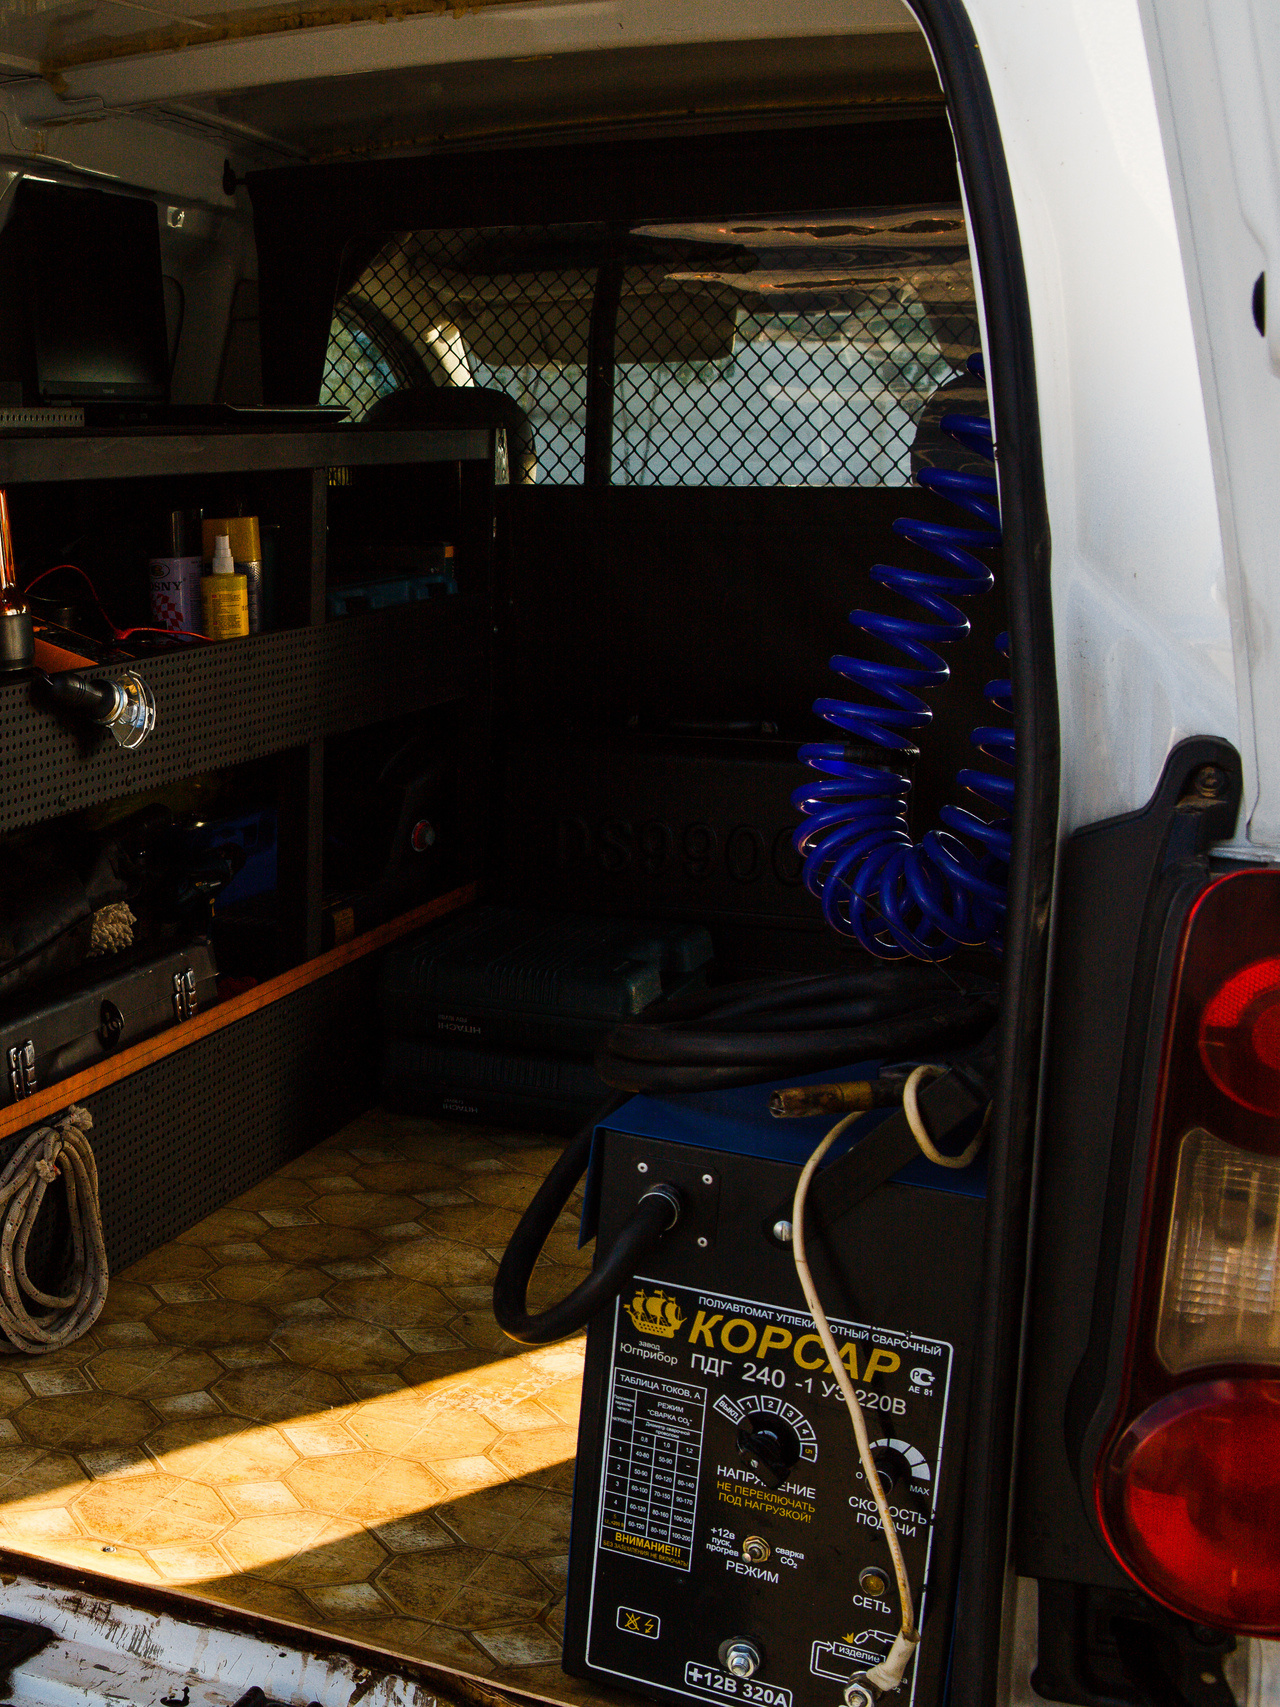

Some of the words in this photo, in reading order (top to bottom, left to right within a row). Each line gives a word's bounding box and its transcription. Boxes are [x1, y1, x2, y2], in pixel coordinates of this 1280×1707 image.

[437, 1021, 482, 1035] HITACHI
[442, 1103, 479, 1114] HITACHI
[698, 1296, 775, 1320] ПОЛУАВТОМАТ
[776, 1312, 870, 1341] УГЛЕКИОТНЫЙ
[871, 1333, 942, 1357] СВАРОЧНЫЙ
[620, 1343, 679, 1366] Югприбор
[638, 1340, 661, 1351] завод
[688, 1310, 901, 1383] КОРСАР
[620, 1374, 660, 1391] ТАБЛИЦА
[661, 1383, 692, 1399] ТОКОВ,
[694, 1392, 701, 1400] А
[690, 1353, 733, 1378] ПДГ
[741, 1362, 786, 1389] 240
[855, 1389, 907, 1415] 220В
[923, 1388, 933, 1397] 81
[657, 1401, 684, 1414] РЕЖИМ
[718, 1400, 739, 1420] ВЫКЛ.
[746, 1401, 753, 1409] 1
[767, 1400, 774, 1409] 2
[786, 1410, 794, 1418] 3
[634, 1468, 649, 1477] 50-90
[655, 1473, 673, 1484] 60-120
[654, 1490, 671, 1500] 70-150
[716, 1480, 732, 1492] НЕ
[734, 1485, 816, 1513] ПЕРЕКЛЮЧАТЬ
[629, 1503, 647, 1513] 60-120
[673, 1514, 693, 1525] 100-200
[718, 1492, 742, 1507] ПОД
[744, 1499, 812, 1524] НАГРУЗКОЙ!
[848, 1496, 927, 1525] СКООСТЬ
[856, 1512, 916, 1538] ПОДЧИ
[615, 1531, 681, 1558] ВНИМАНИЕ!!!
[671, 1532, 692, 1542] 100-200
[711, 1536, 732, 1548] пуск,
[602, 1540, 614, 1548] БЕЗ
[614, 1542, 650, 1557] ЗАЗЕМЛЕНИЯ
[650, 1551, 658, 1560] НЕ
[706, 1543, 739, 1557] прогрев
[775, 1547, 805, 1560] сварка
[725, 1559, 779, 1584] РЕЖИМ
[852, 1594, 892, 1614] СЕТЬ
[838, 1646, 880, 1663] изделие
[688, 1667, 737, 1693] +12В
[742, 1683, 788, 1707] 320А
